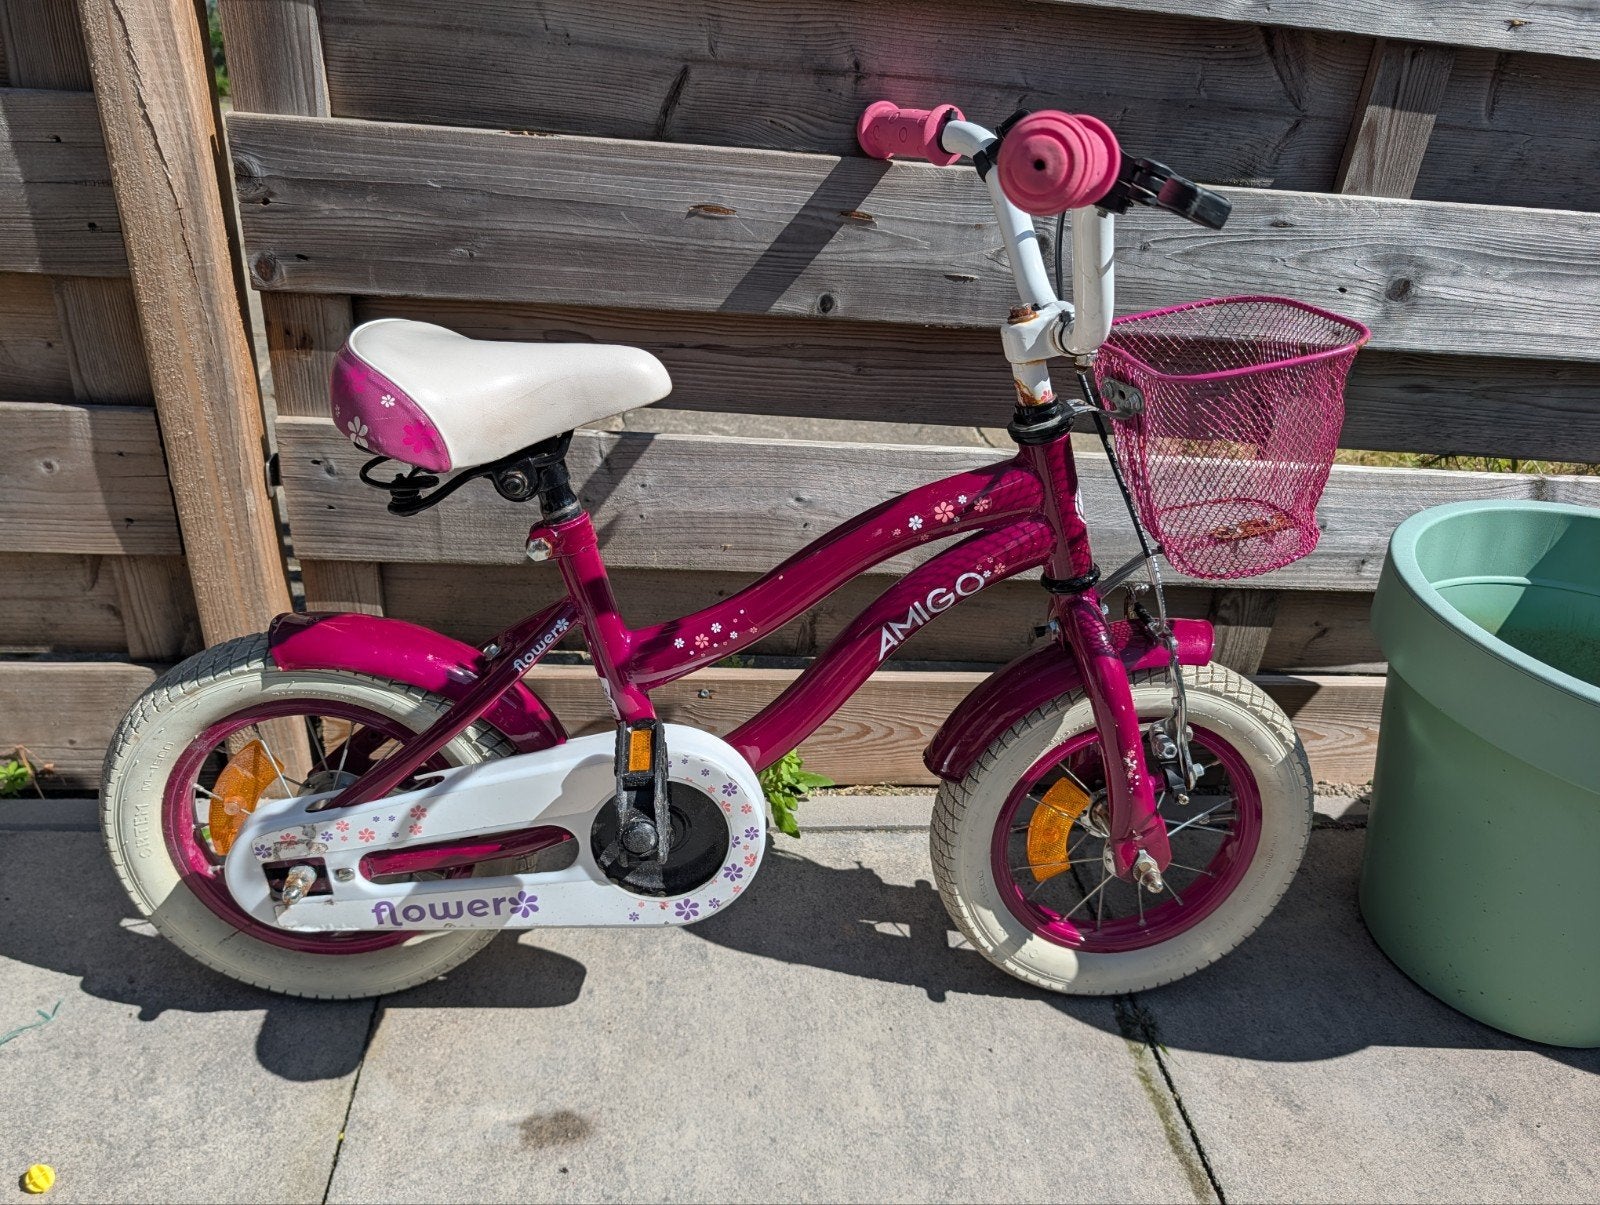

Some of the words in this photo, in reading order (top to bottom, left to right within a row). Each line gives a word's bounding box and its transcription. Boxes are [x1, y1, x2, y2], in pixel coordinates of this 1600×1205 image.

[878, 571, 985, 662] AMIGO
[513, 627, 559, 672] flower
[371, 896, 506, 927] flower
